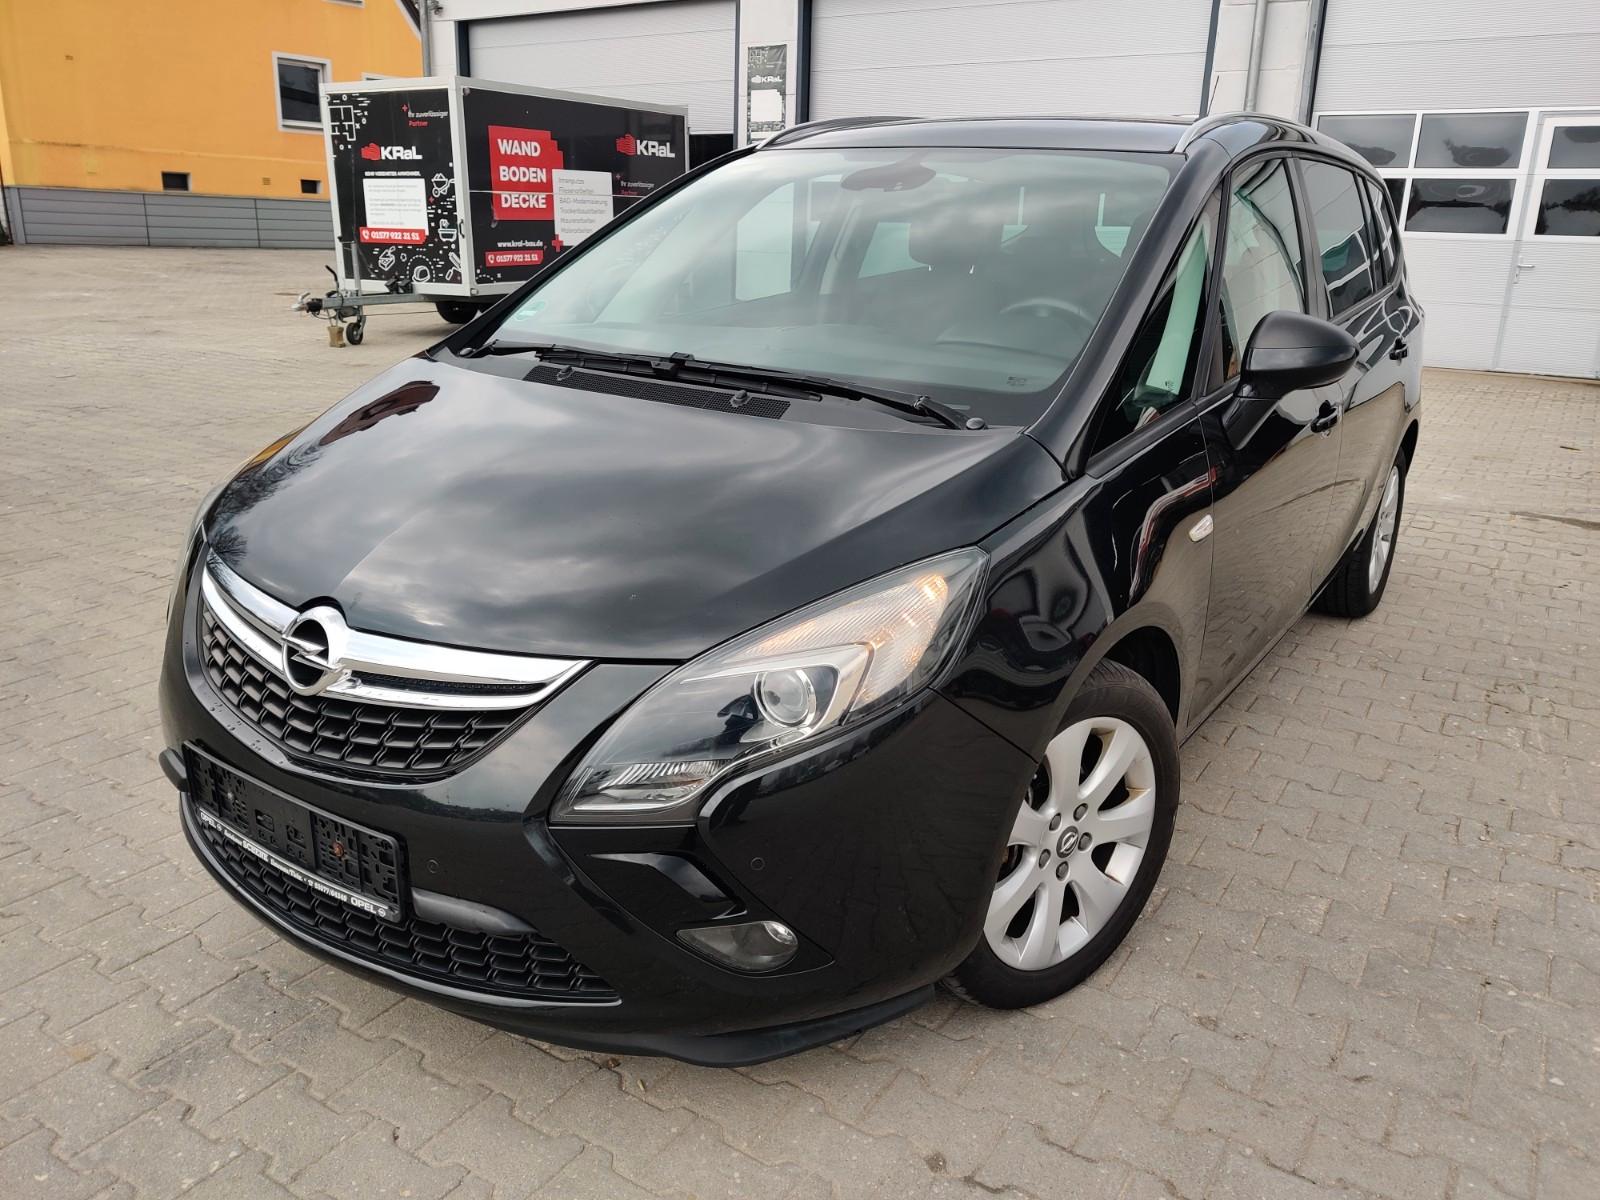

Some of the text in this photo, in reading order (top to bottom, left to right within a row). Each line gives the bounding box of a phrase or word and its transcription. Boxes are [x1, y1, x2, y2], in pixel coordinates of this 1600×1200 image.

[380, 146, 423, 160] KRaL
[497, 138, 541, 157] WAND
[636, 140, 675, 158] KRaL
[499, 166, 546, 183] BODEN
[501, 193, 547, 209] DECKE
[200, 811, 217, 829] OPEL
[350, 896, 377, 915] OPEL
